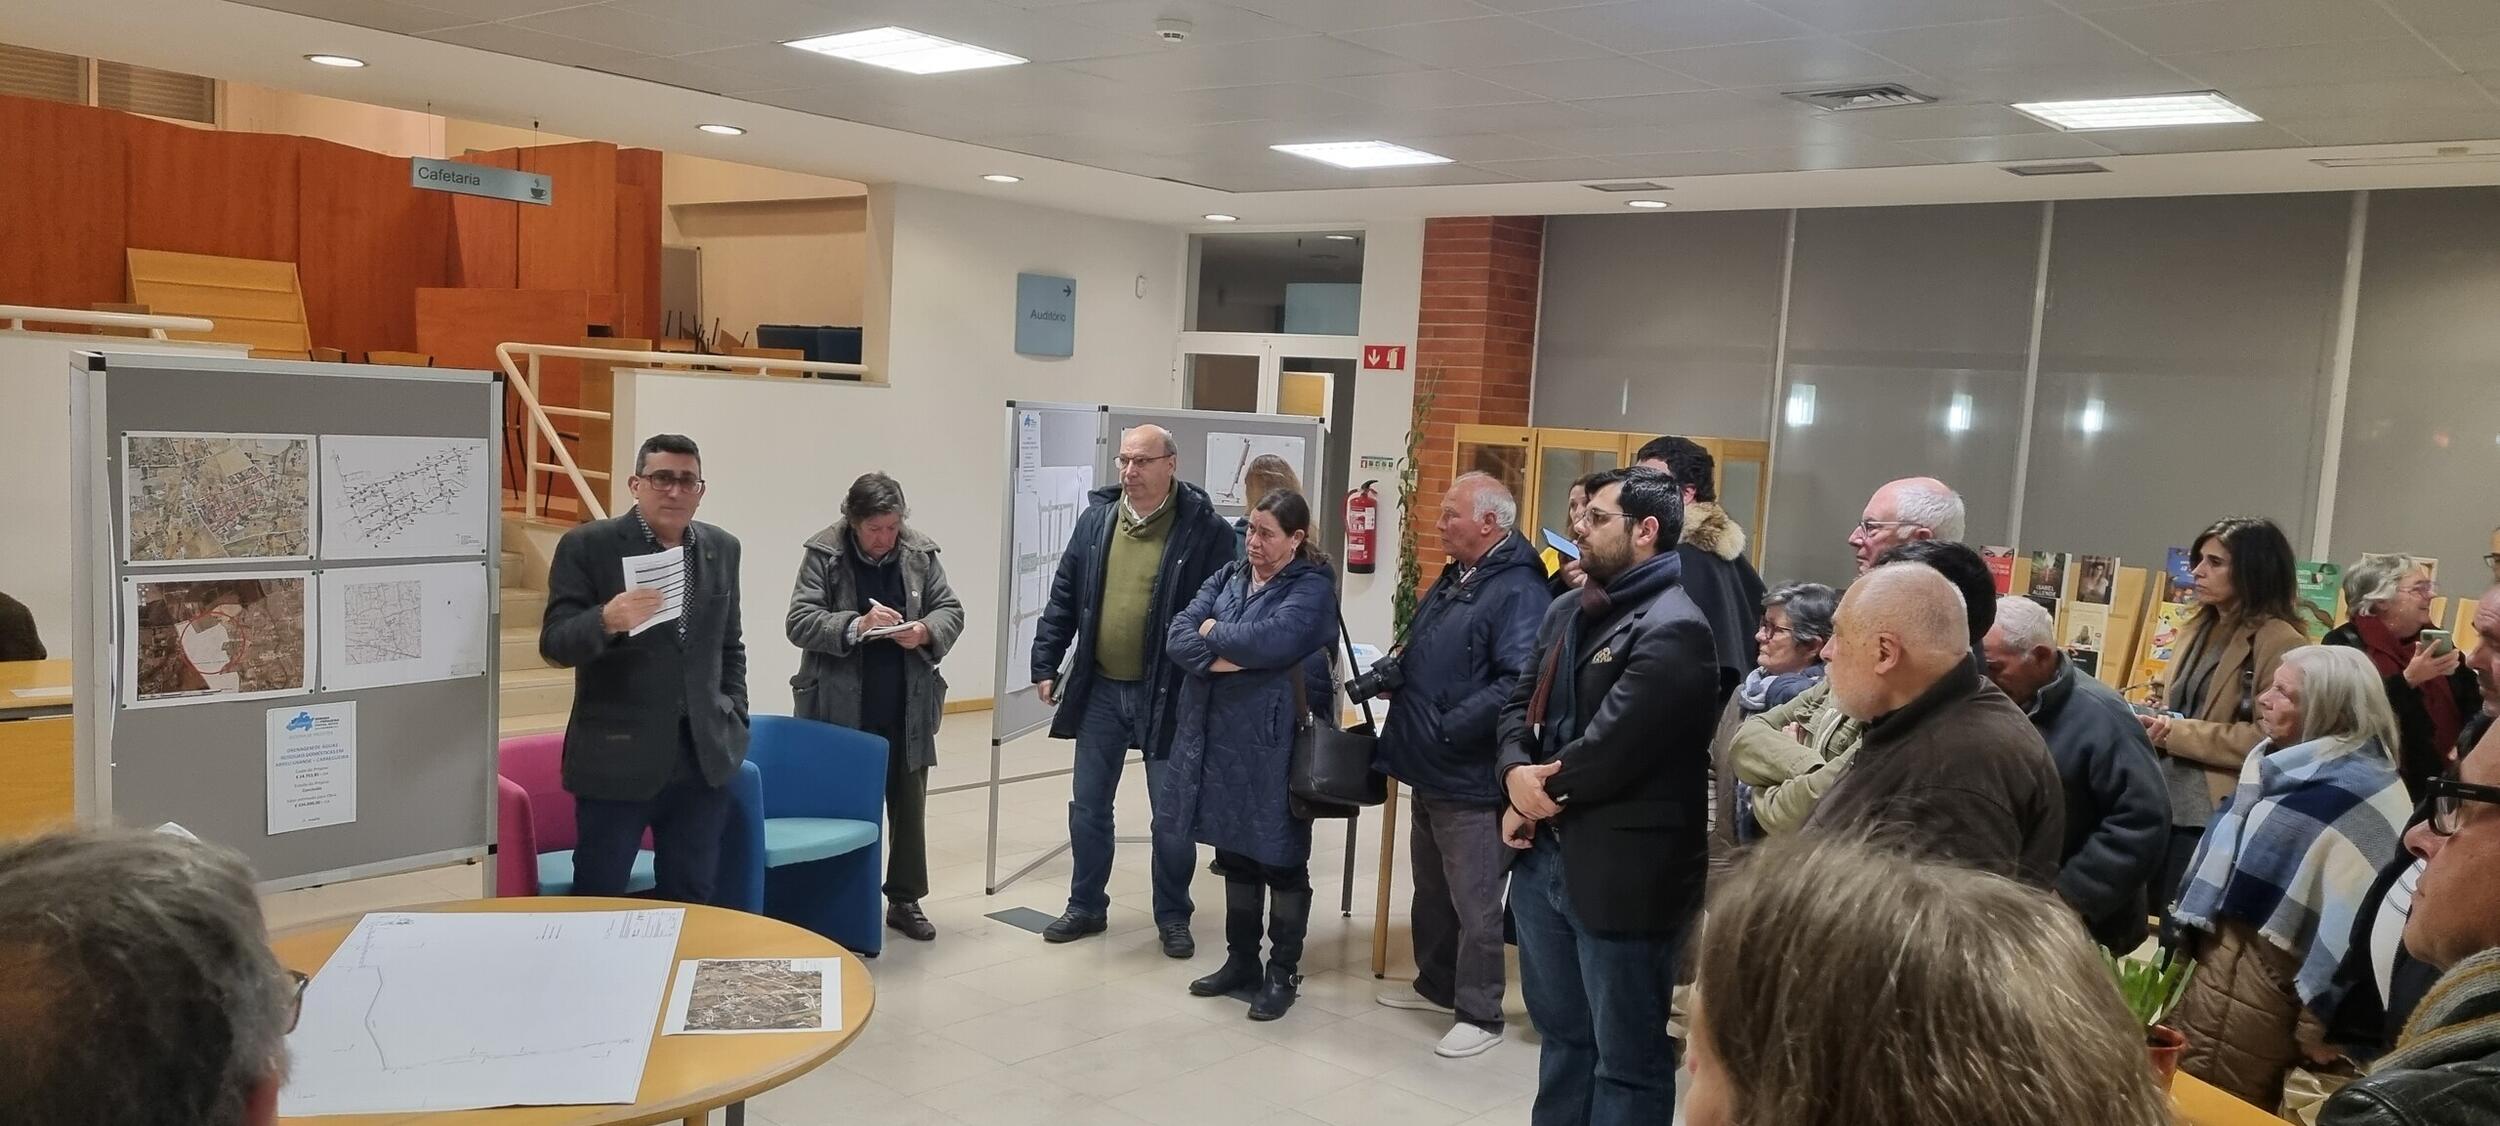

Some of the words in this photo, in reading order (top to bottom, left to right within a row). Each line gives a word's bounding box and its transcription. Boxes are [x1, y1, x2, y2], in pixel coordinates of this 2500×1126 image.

[418, 167, 480, 186] Cafetaria
[1030, 309, 1066, 322] Auditório
[2036, 584, 2054, 592] ISABEL
